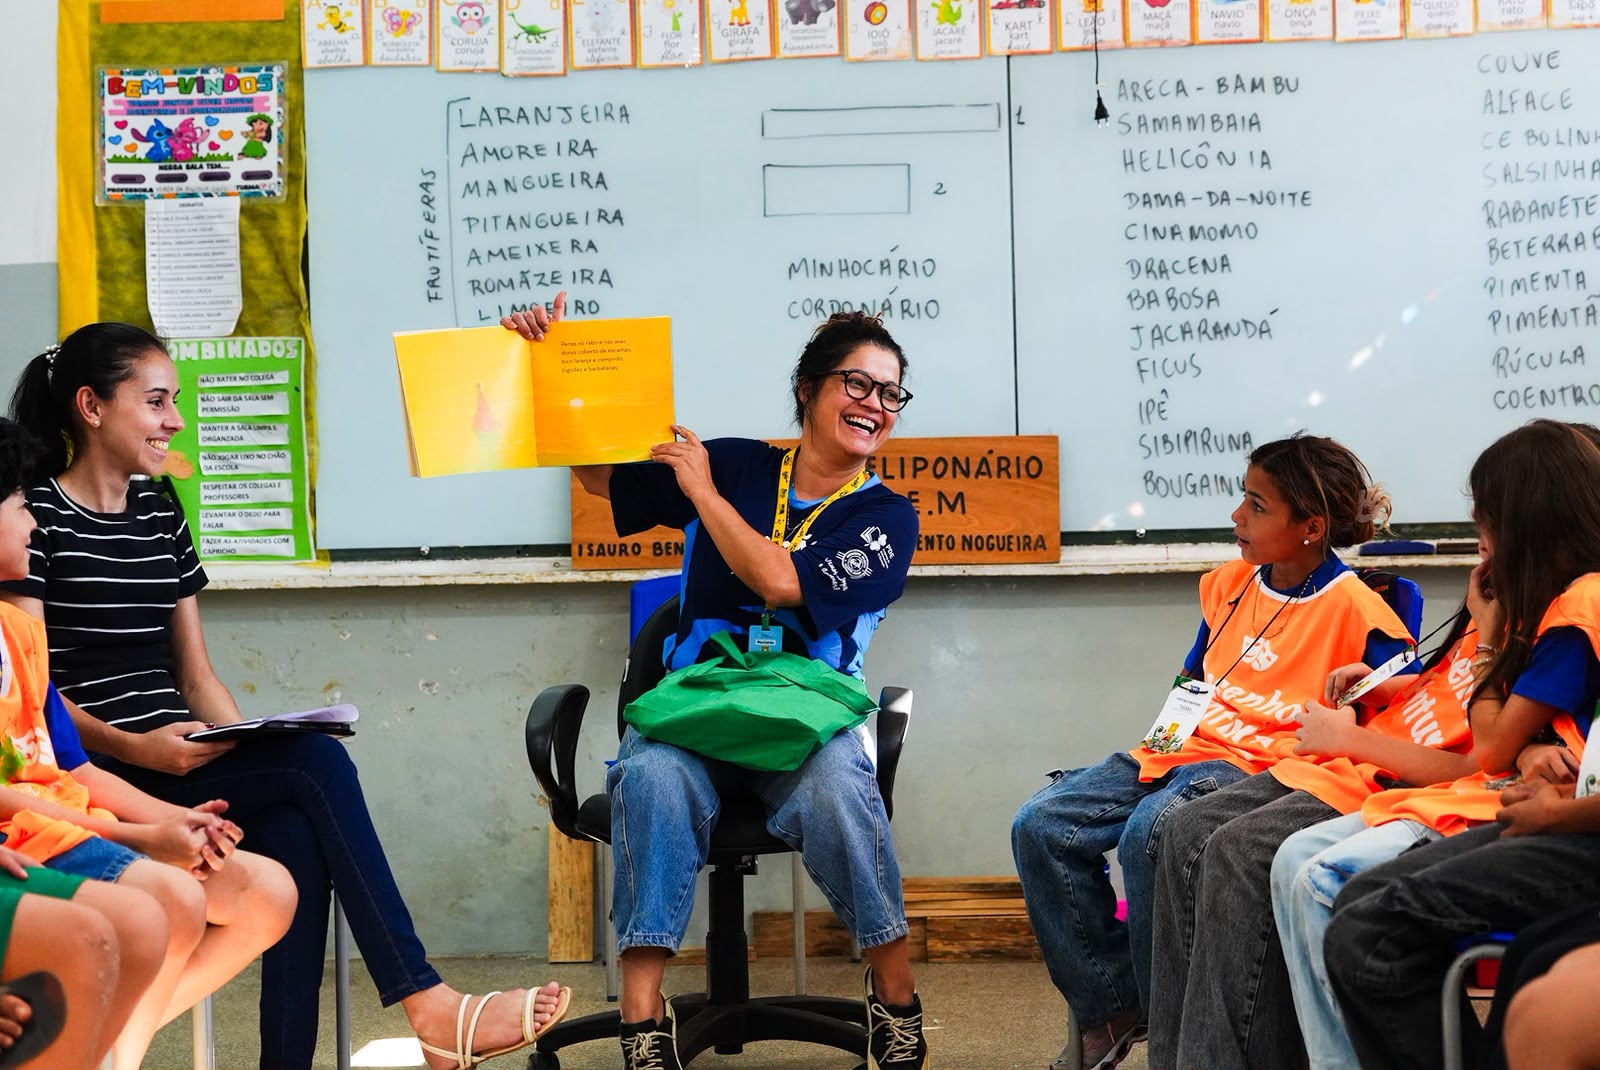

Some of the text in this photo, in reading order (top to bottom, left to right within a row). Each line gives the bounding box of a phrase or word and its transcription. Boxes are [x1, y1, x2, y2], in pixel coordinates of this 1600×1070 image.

[1210, 10, 1244, 19] NAVIO
[1284, 8, 1317, 20] ONÇA
[1355, 10, 1380, 18] PEIXE
[1424, 0, 1459, 10] QUEIJO
[1502, 6, 1524, 15] rato
[1568, 1, 1595, 10] sapo
[1005, 21, 1033, 30] KART
[1143, 10, 1172, 21] MAÇÃ
[1145, 21, 1170, 30] maçã
[1214, 20, 1241, 28] navio
[1290, 20, 1312, 28] onça
[721, 27, 760, 38] GIRAFA
[868, 28, 890, 39] IOIÔ
[932, 26, 966, 36] JACARÉ
[1009, 30, 1028, 40] kart
[450, 37, 488, 46] CORUJA
[455, 47, 484, 56] coruja
[582, 38, 621, 47] ELEFANTE
[664, 40, 680, 48] flor
[728, 37, 754, 47] girafa
[1478, 50, 1560, 74] COUVE
[108, 73, 273, 98] BEM-VINDOS
[1482, 88, 1573, 116] ALFACE
[458, 102, 630, 128] LARANJEIRA
[1118, 112, 1262, 136] SAMAMBAIA
[460, 138, 598, 168] AMOREIRA
[1122, 141, 1272, 174] HELICÔNIA
[1482, 159, 1600, 188] SALSINHA
[462, 171, 608, 199] MANGUEIRA
[933, 182, 947, 195] 2
[1123, 190, 1312, 210] DAMA-DA-NOITE
[462, 208, 625, 234] PITANGUEIRA
[1482, 194, 1600, 229] RABANETE
[418, 168, 443, 303] FRUTÍFERAS
[1124, 222, 1258, 242] CINAMOMO
[788, 244, 936, 280] MINHOCÁRIO
[1126, 254, 1232, 280] DRACENA
[468, 268, 614, 296] ROMÃZEIRA
[1484, 269, 1586, 300] PIMENTA
[788, 286, 940, 320] CORDONÁRIO
[1126, 286, 1220, 312] BABOSA
[1130, 308, 1280, 351] JACARANDÁ
[168, 339, 297, 361] OMBINADOS
[1136, 353, 1202, 384] FICUS
[1492, 345, 1586, 379] RÚCULA
[1138, 388, 1169, 425] IPÊ
[1493, 384, 1600, 410] COENTRO
[202, 405, 240, 413] PERMISSÃO
[1138, 427, 1253, 460] SIBIPIRUNA
[577, 542, 642, 558] ISAURO
[886, 544, 894, 559] PDE
[961, 534, 1047, 552] NOGUEIRA
